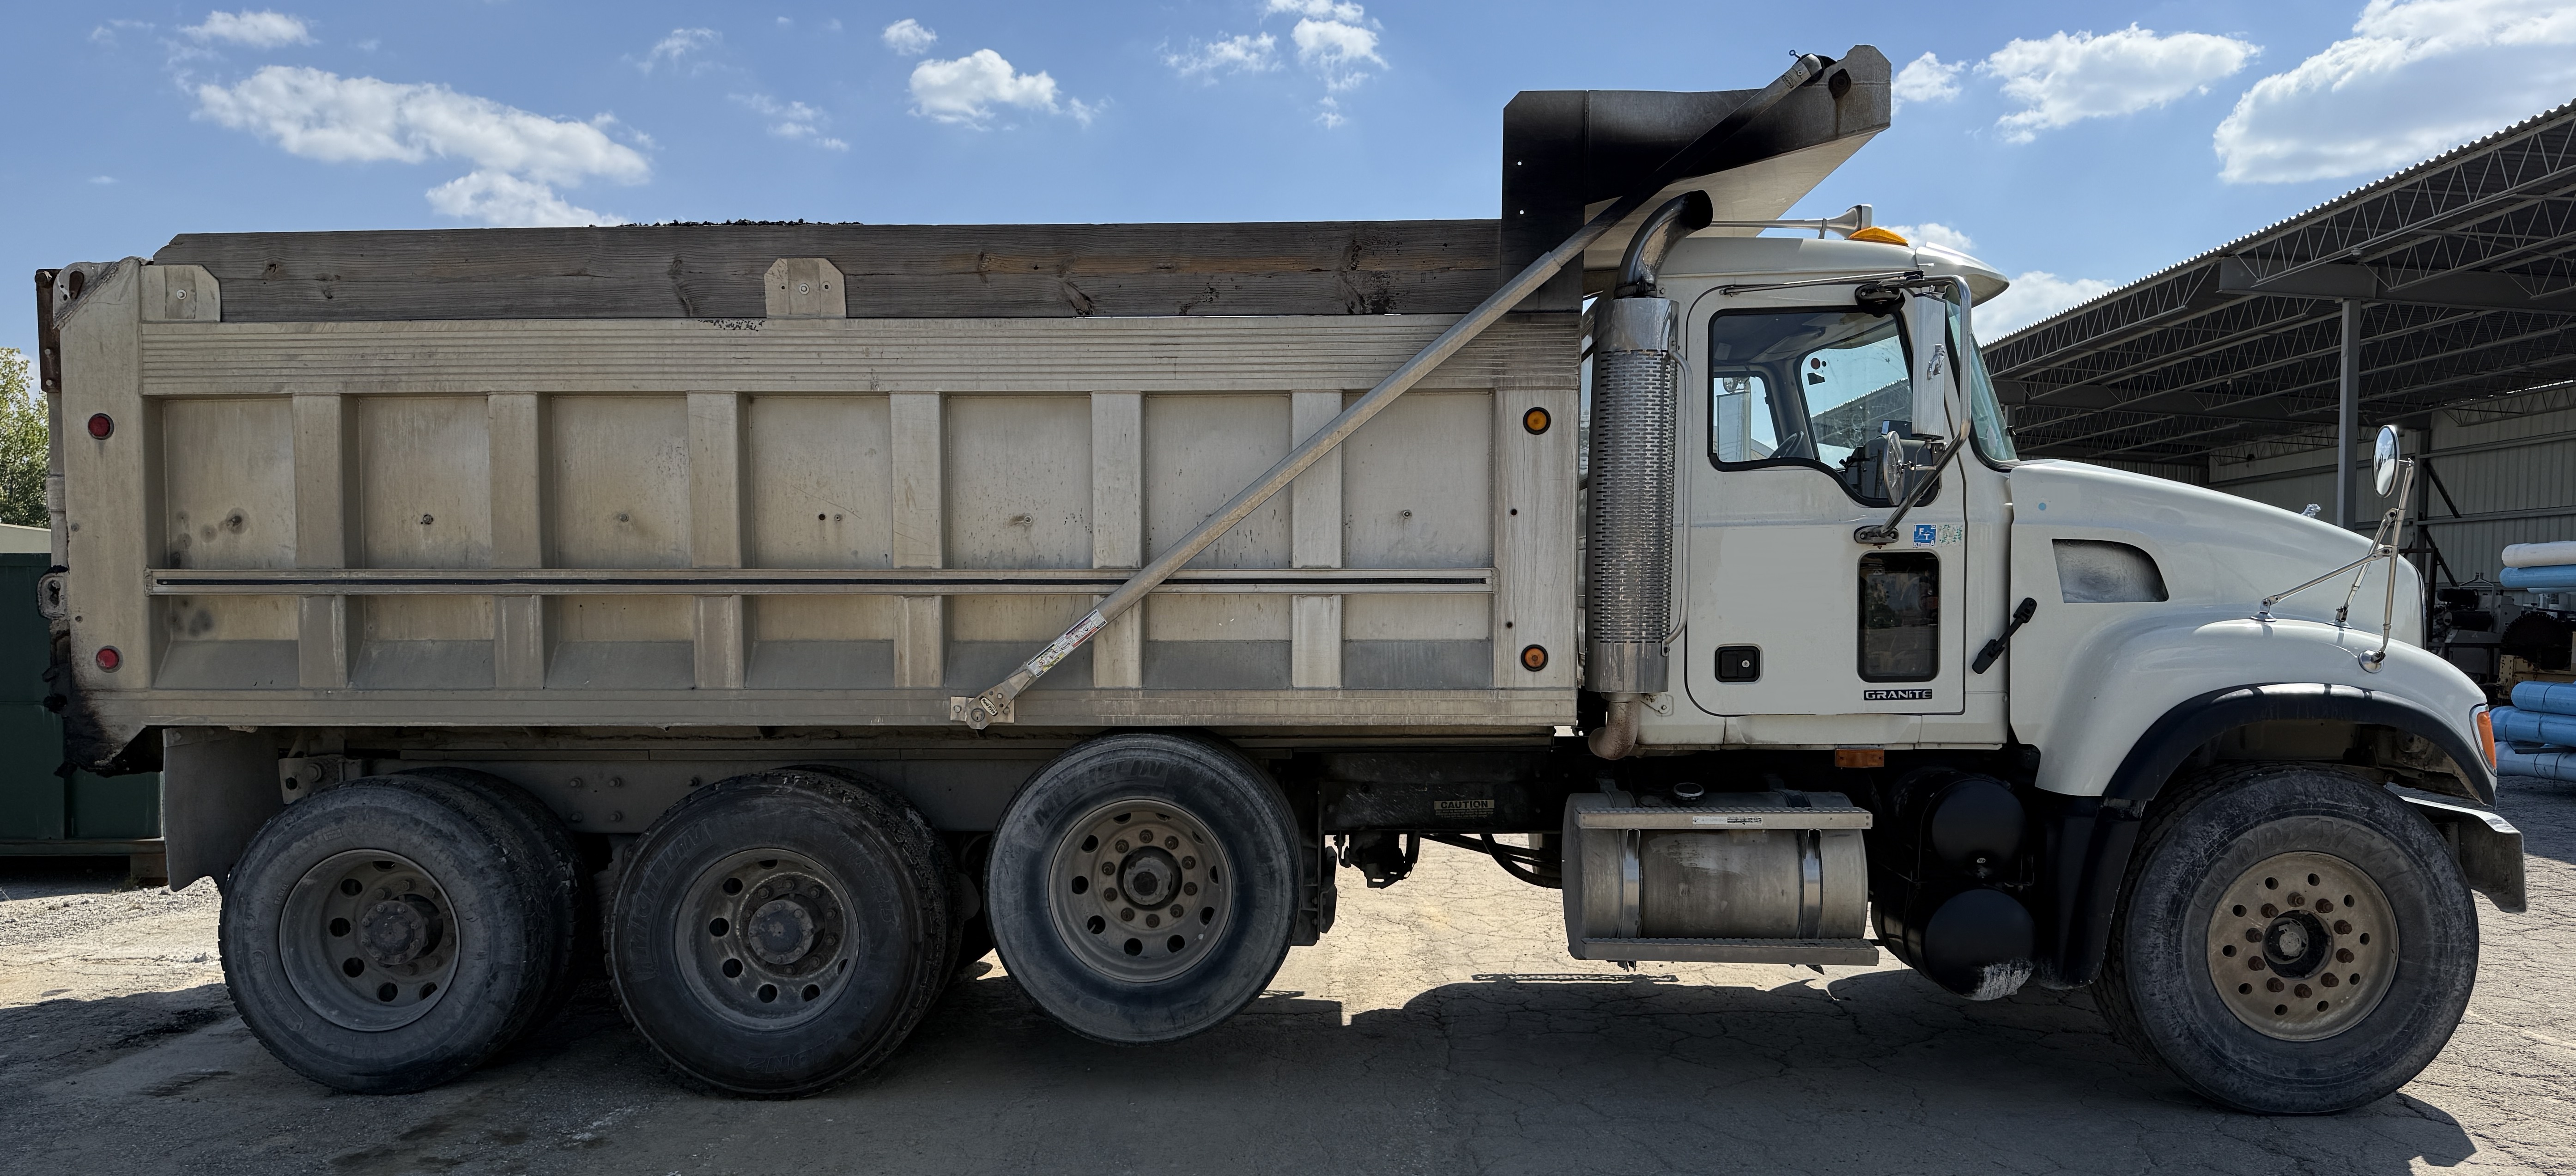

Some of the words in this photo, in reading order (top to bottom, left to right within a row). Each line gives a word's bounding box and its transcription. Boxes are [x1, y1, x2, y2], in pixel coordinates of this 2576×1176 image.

[1033, 760, 1165, 827] MICHELIN
[1441, 800, 1488, 809] CAUTION
[630, 823, 703, 957] MICHELIN
[2194, 817, 2423, 909] GOODYEAR
